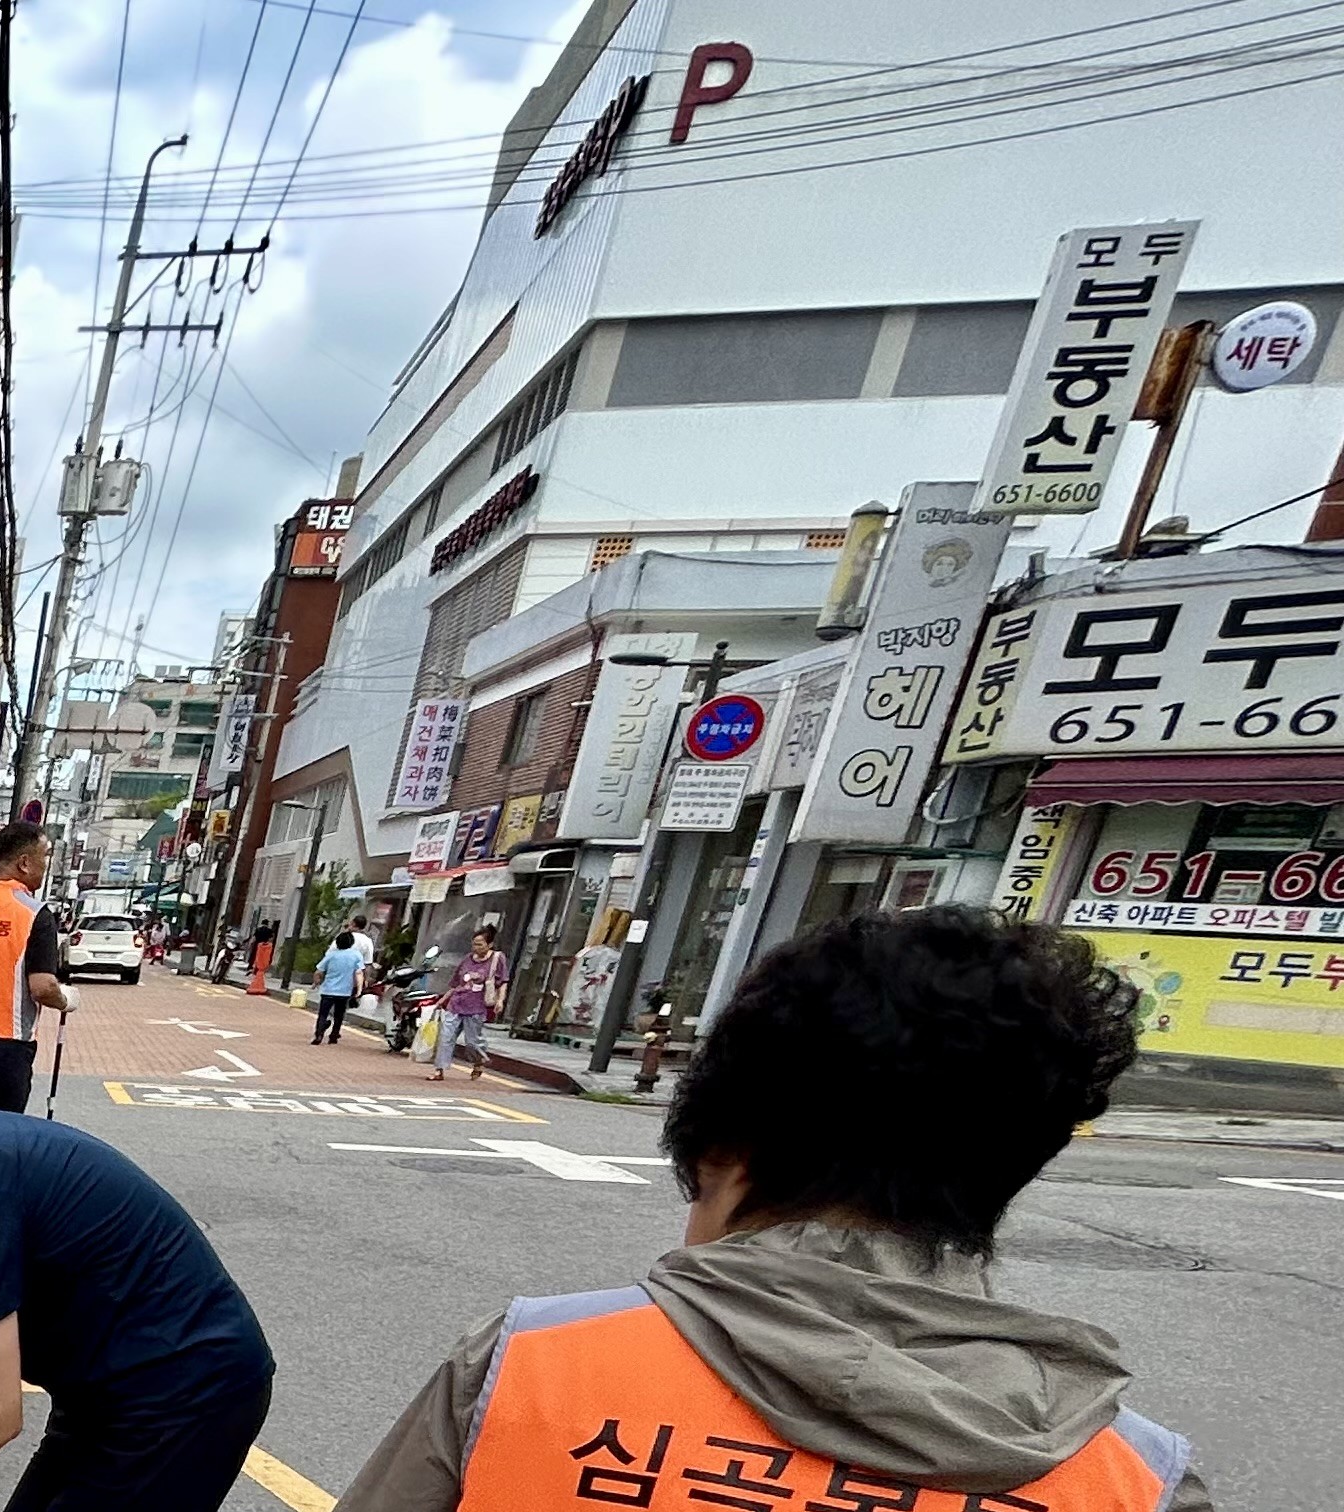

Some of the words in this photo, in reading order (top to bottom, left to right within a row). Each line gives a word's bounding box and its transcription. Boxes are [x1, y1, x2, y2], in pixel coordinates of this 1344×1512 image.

[669, 40, 754, 146] P
[1022, 275, 1159, 476] 부동산
[1225, 335, 1303, 372] 세탁
[991, 479, 1104, 505] 651-6600
[877, 617, 961, 656] 박지향
[958, 609, 1037, 755] 부동산
[1041, 589, 1344, 697] 모두
[838, 665, 944, 808] 헤어
[1073, 903, 1120, 925] 신축
[1127, 904, 1199, 926] 아파트
[1204, 907, 1311, 932] 오피스텔
